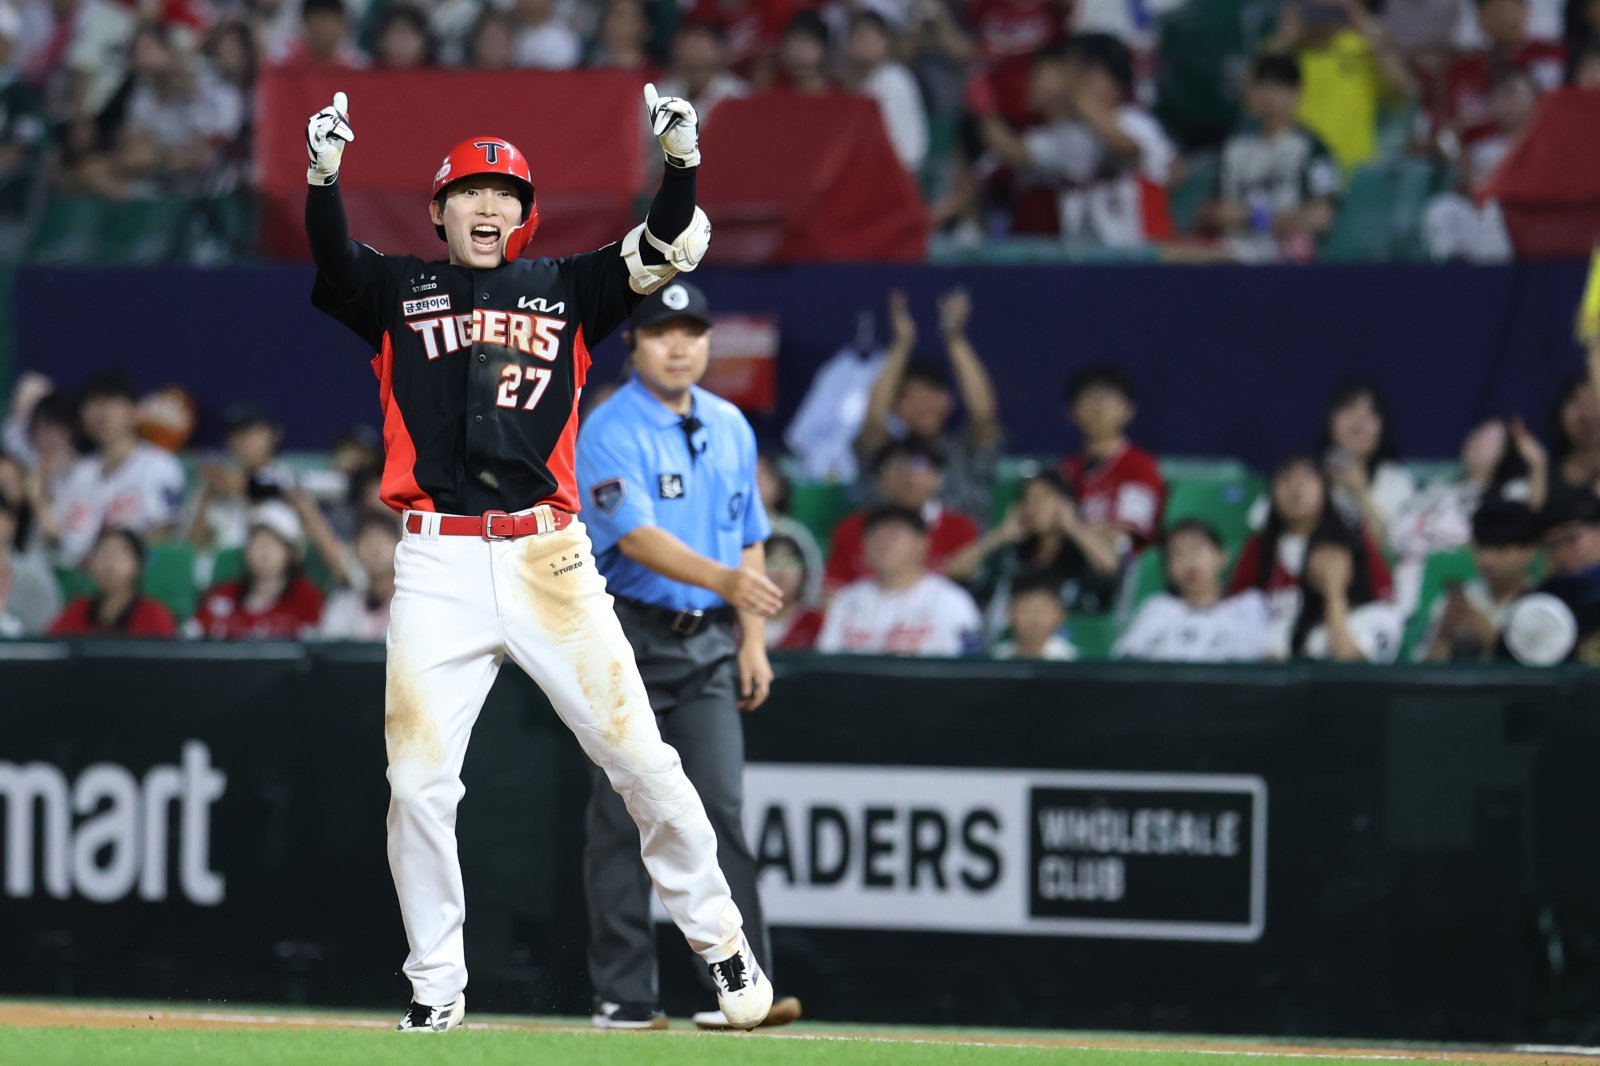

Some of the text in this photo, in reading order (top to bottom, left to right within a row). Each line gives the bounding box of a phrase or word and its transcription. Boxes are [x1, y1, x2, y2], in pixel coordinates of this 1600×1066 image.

[473, 141, 508, 165] T
[405, 297, 450, 314] 금호타이어
[404, 309, 567, 362] TIGERS
[496, 363, 552, 411] 27
[553, 561, 583, 577] STUDIO
[1037, 805, 1241, 857] WHOLESALE
[1038, 855, 1126, 901] CLUB
